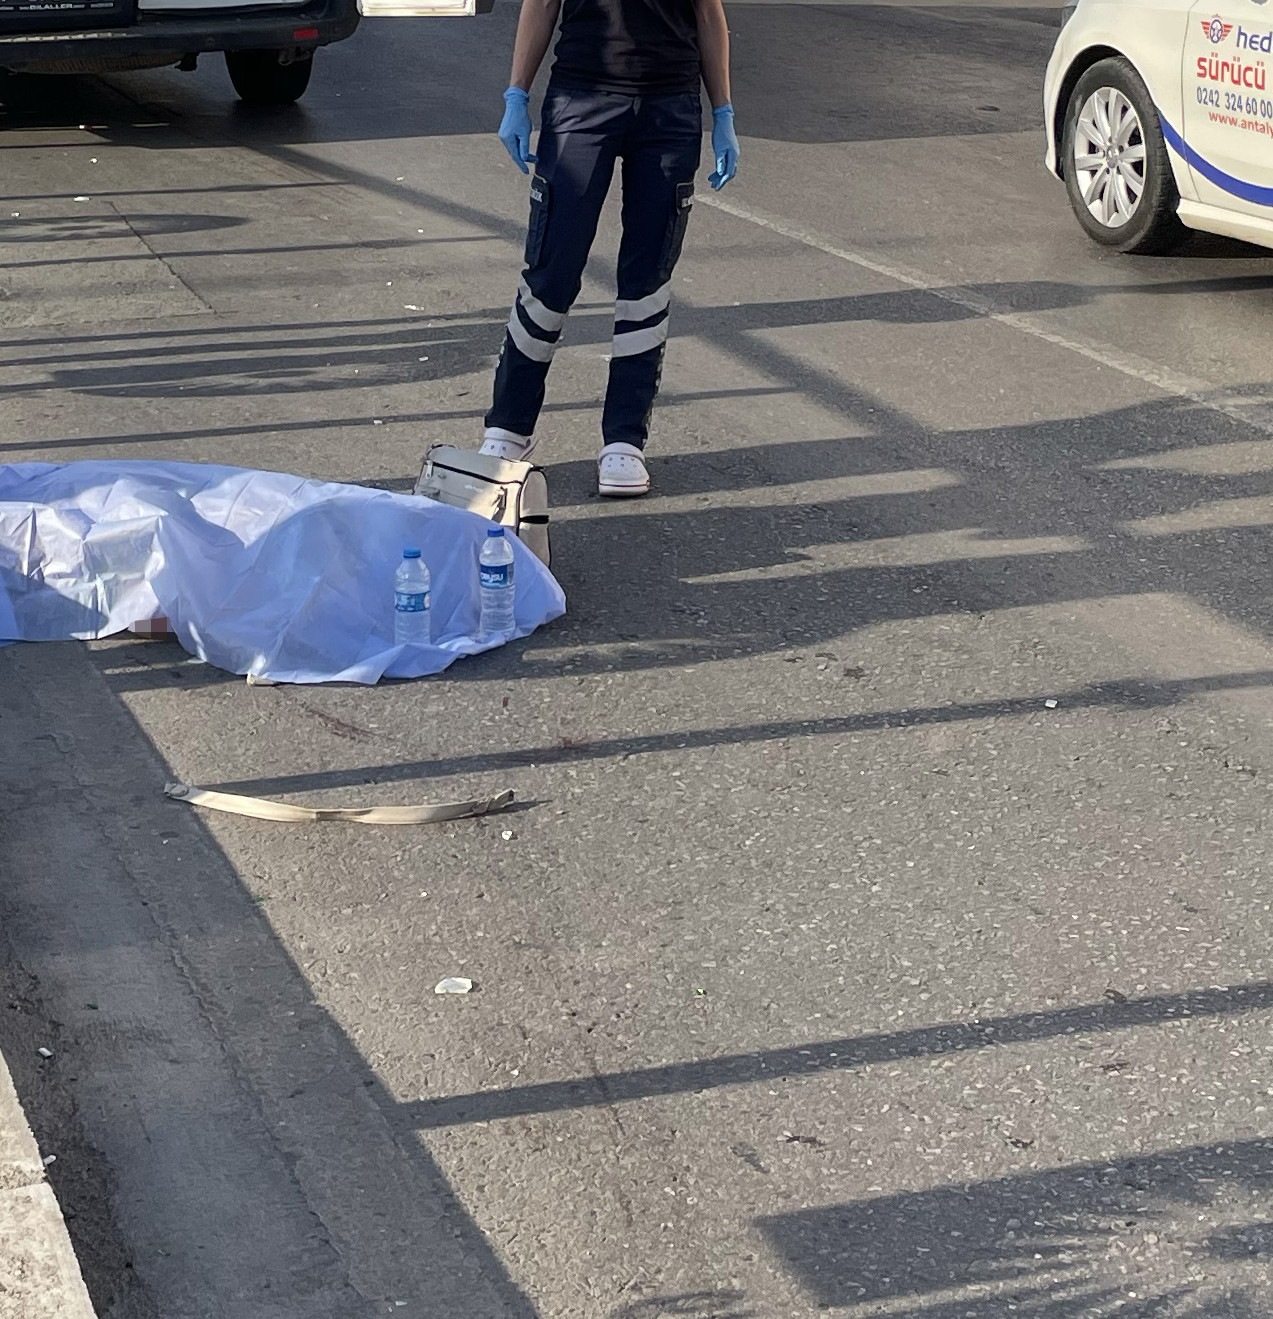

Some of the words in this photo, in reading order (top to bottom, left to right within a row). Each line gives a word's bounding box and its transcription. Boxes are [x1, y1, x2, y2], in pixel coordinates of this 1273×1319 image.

[1196, 52, 1265, 90] sürücü
[1196, 86, 1220, 108] 0242
[1224, 92, 1243, 113] 324
[1245, 97, 1258, 115] 60
[1260, 100, 1273, 119] 00
